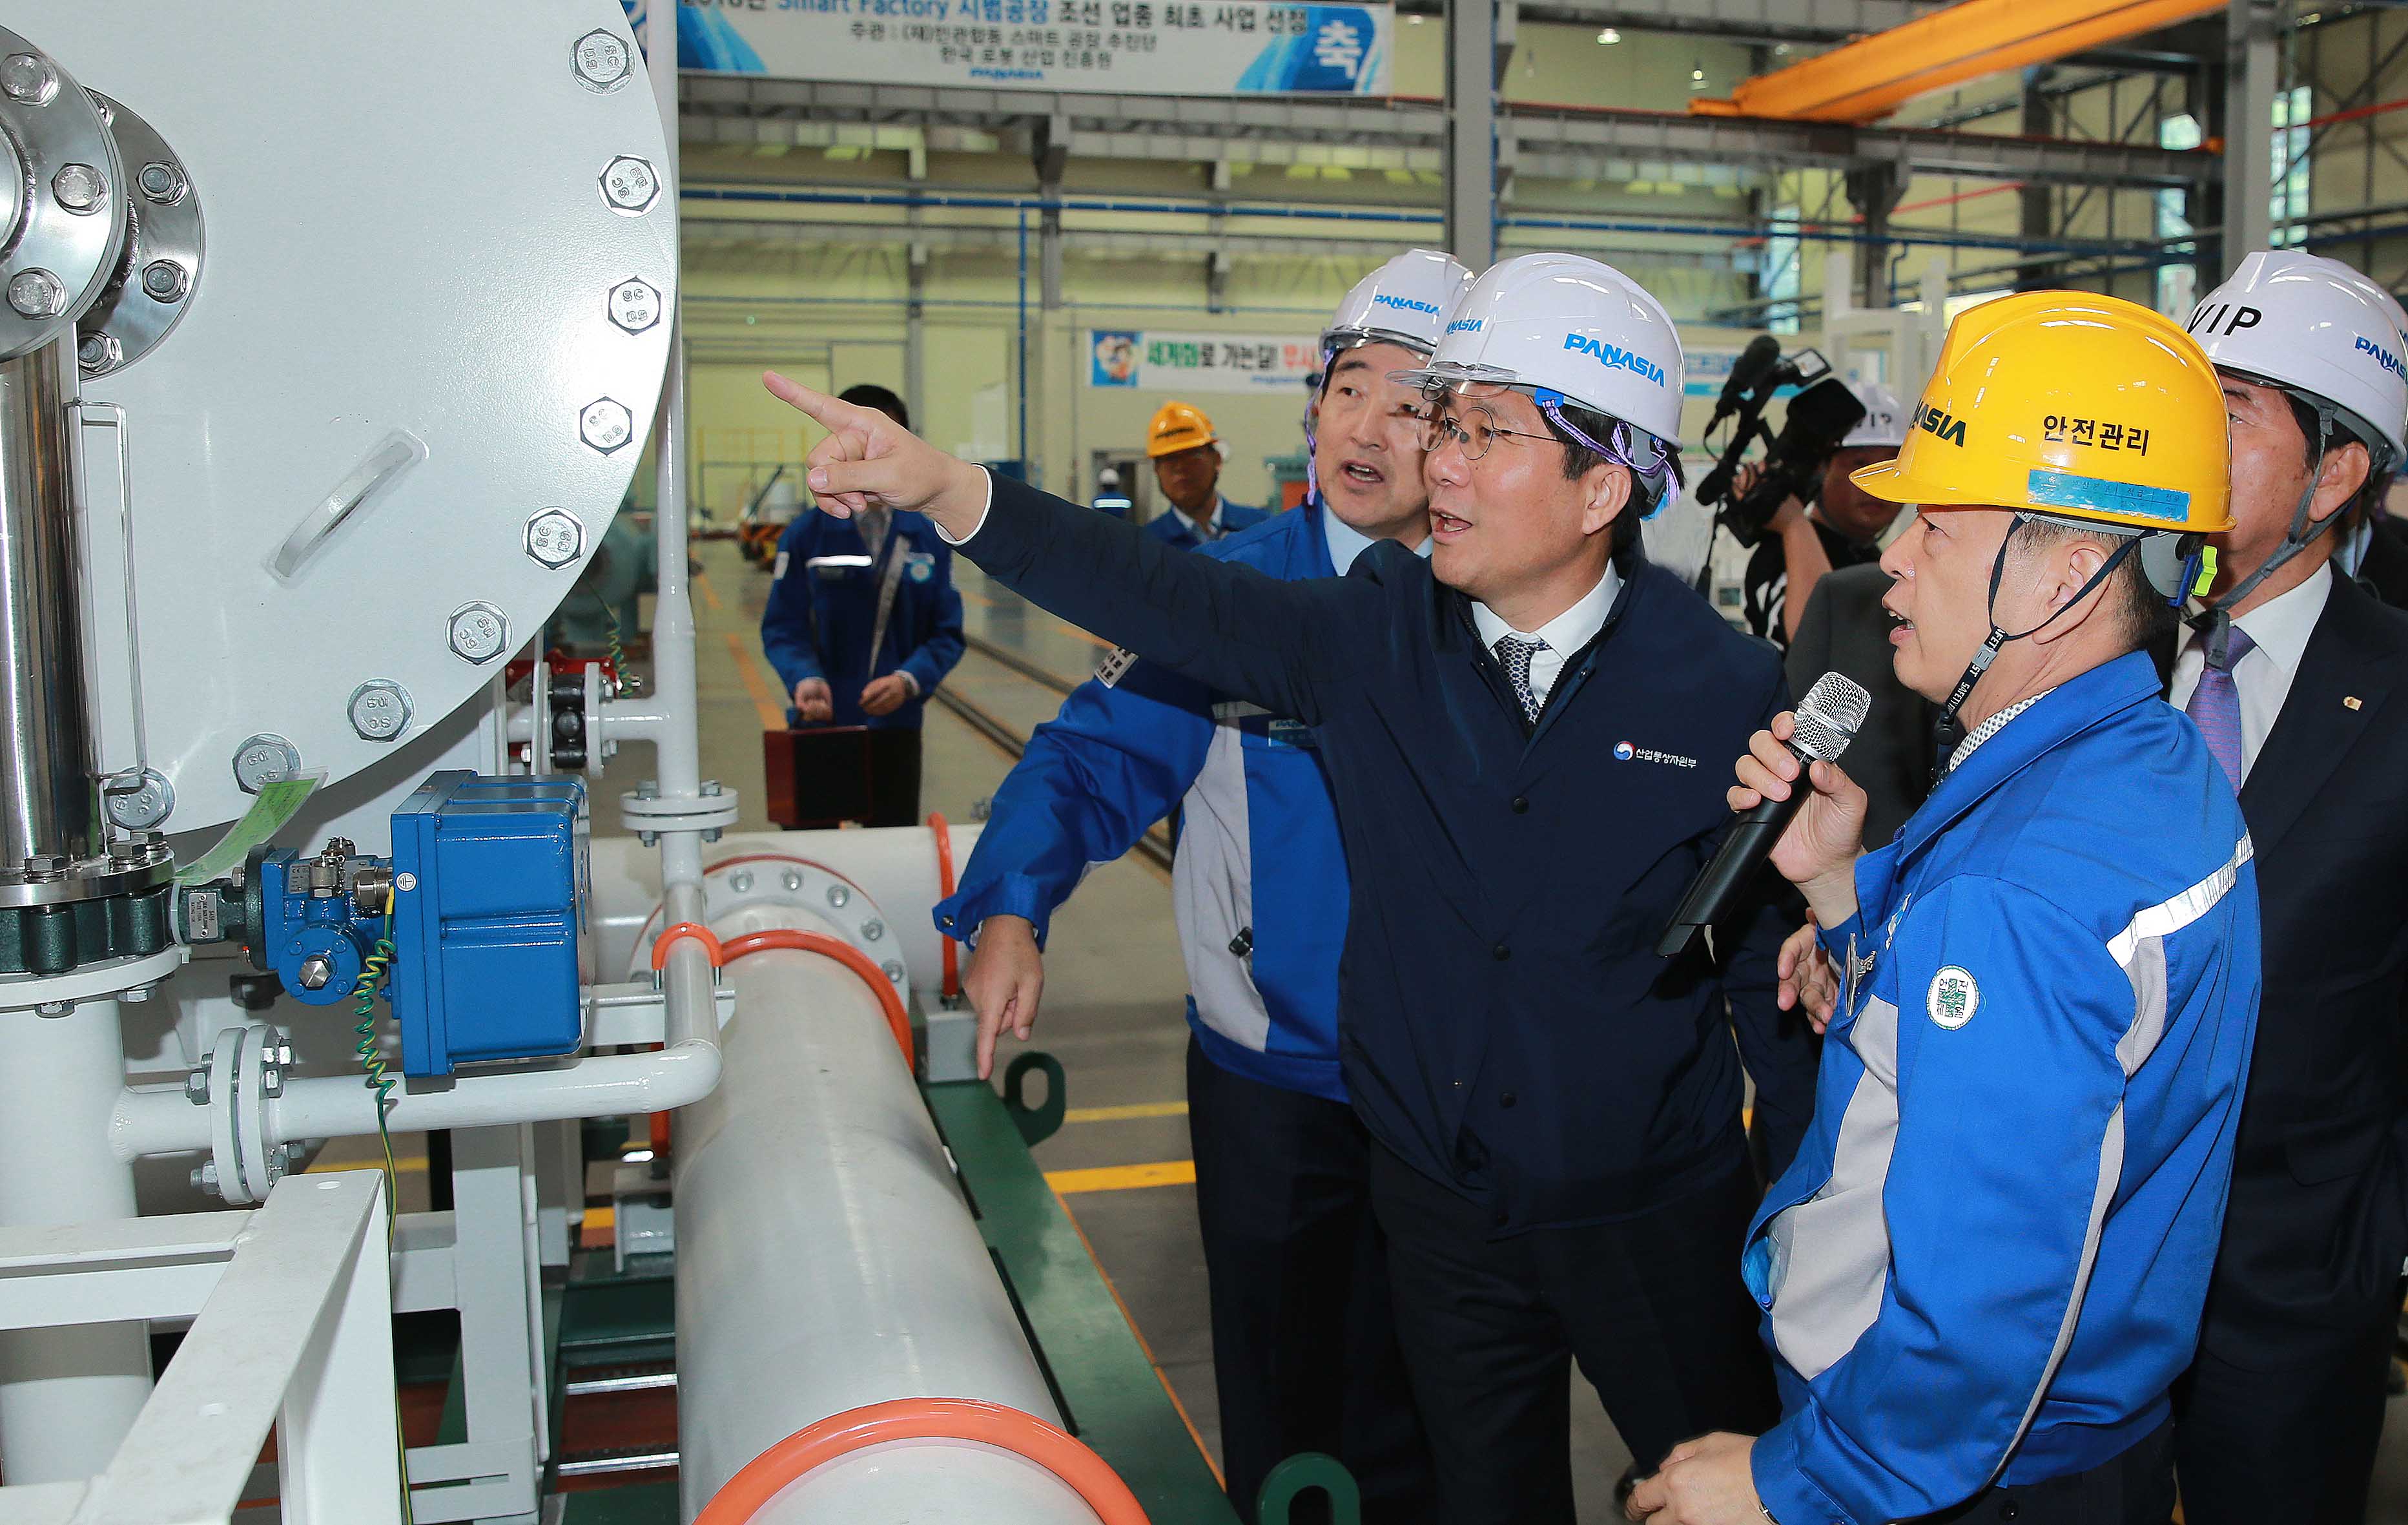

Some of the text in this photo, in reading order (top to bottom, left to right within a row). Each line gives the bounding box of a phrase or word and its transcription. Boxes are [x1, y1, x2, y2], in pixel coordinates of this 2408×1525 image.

[859, 0, 949, 21] Factory
[1059, 1, 1100, 25] 조선
[1111, 3, 1152, 28] 업종
[1164, 5, 1204, 28] 최초
[1214, 7, 1255, 32] 사업
[1267, 8, 1306, 34] 선정
[1314, 20, 1362, 79] 축
[1374, 294, 1441, 316] PANASIA
[2187, 303, 2262, 336] VIP
[1446, 318, 1483, 335] NASIA
[1563, 333, 1665, 388] PANASIA
[2043, 415, 2150, 457] 안전관리
[1951, 681, 1970, 707] SAFETY
[1636, 749, 1696, 769] 산업통상자원부
